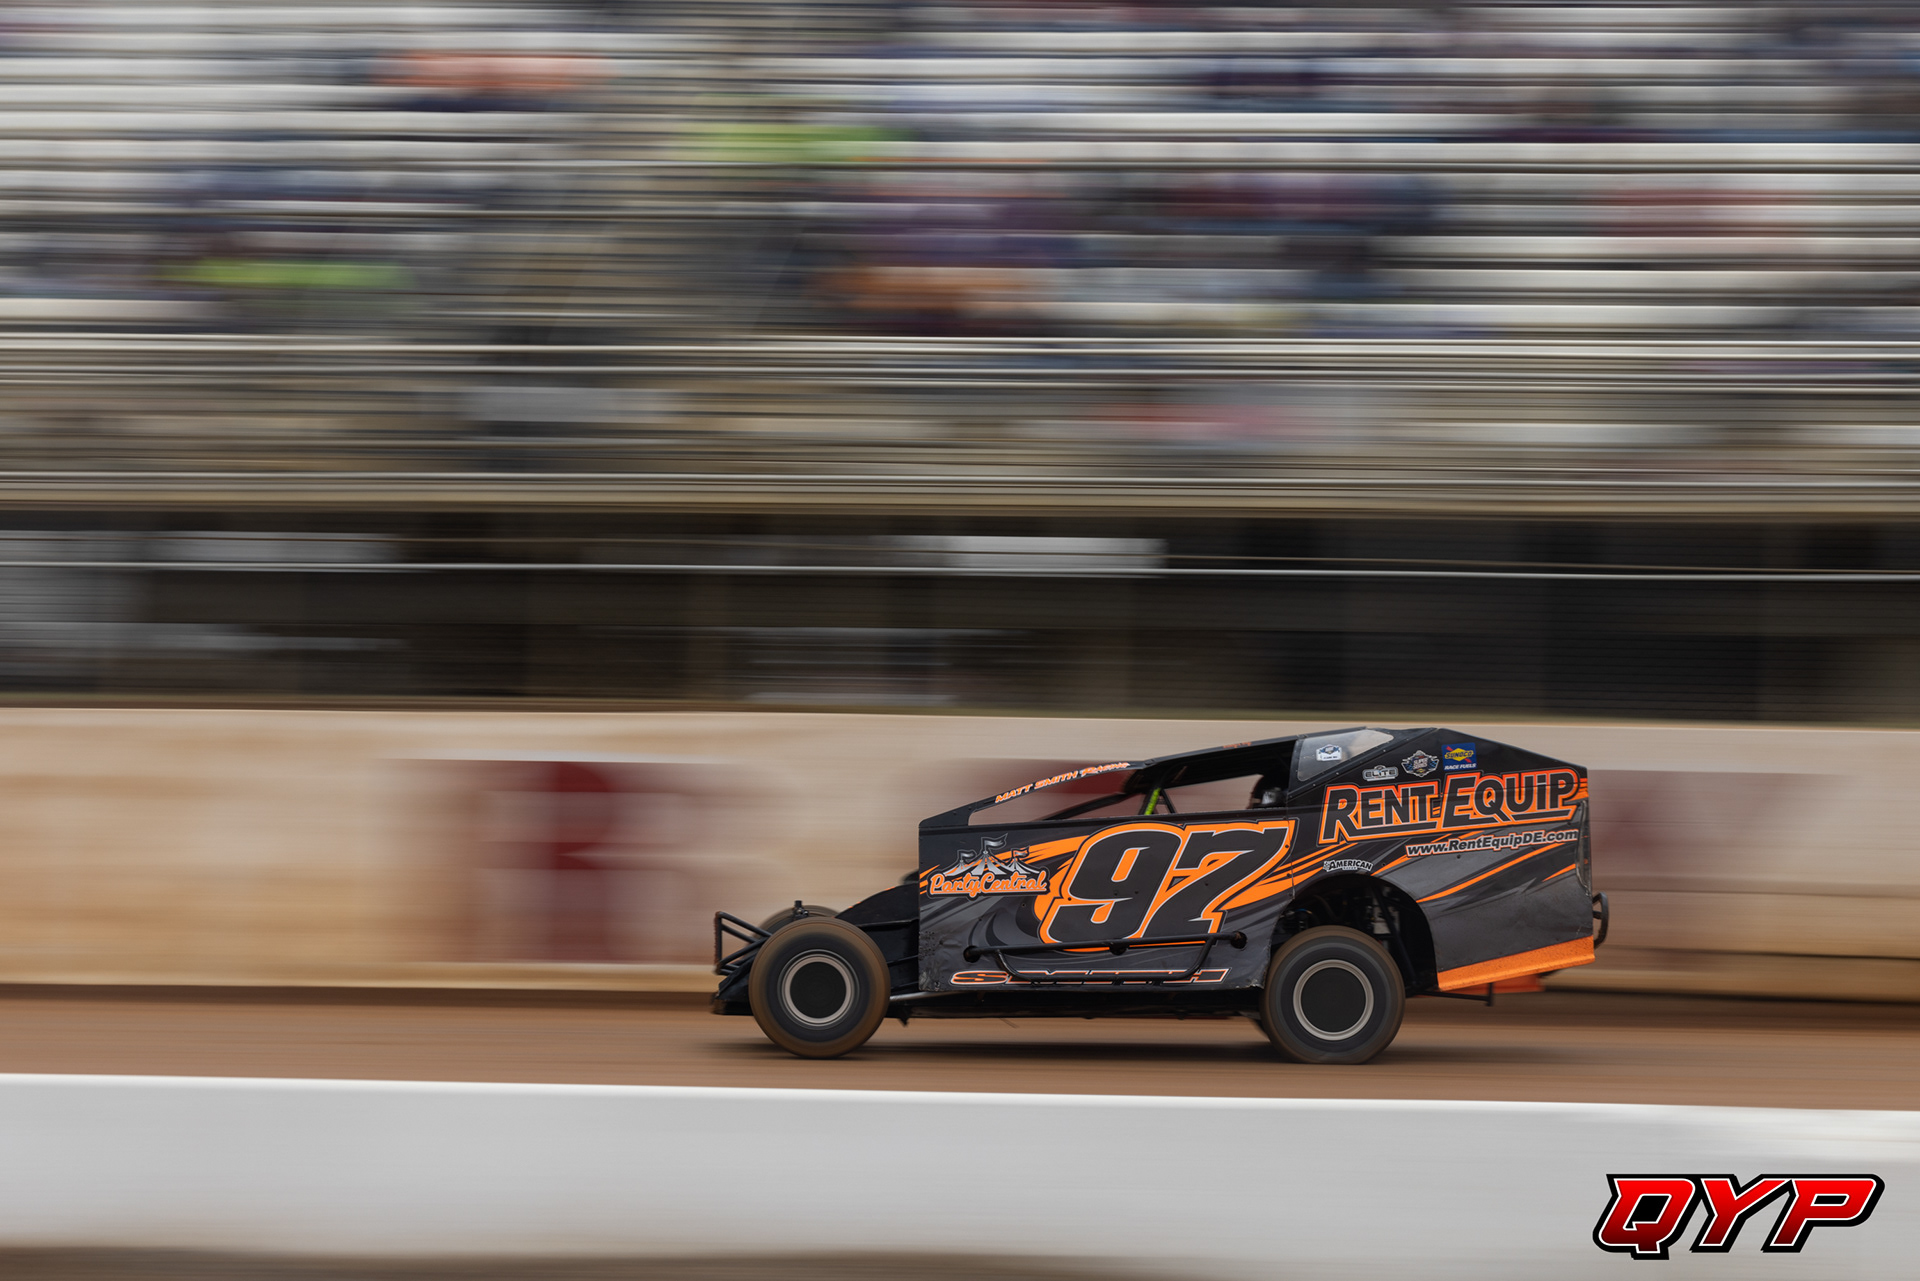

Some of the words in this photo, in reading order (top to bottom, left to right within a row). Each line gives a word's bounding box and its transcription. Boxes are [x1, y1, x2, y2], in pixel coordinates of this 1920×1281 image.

[1445, 750, 1474, 759] SUNOCO
[995, 783, 1034, 803] MATT
[1034, 770, 1079, 789] SMITH
[1406, 829, 1579, 856] www.RentEquipDE.com
[1328, 860, 1373, 871] AMERICAN
[1041, 820, 1294, 950] 97
